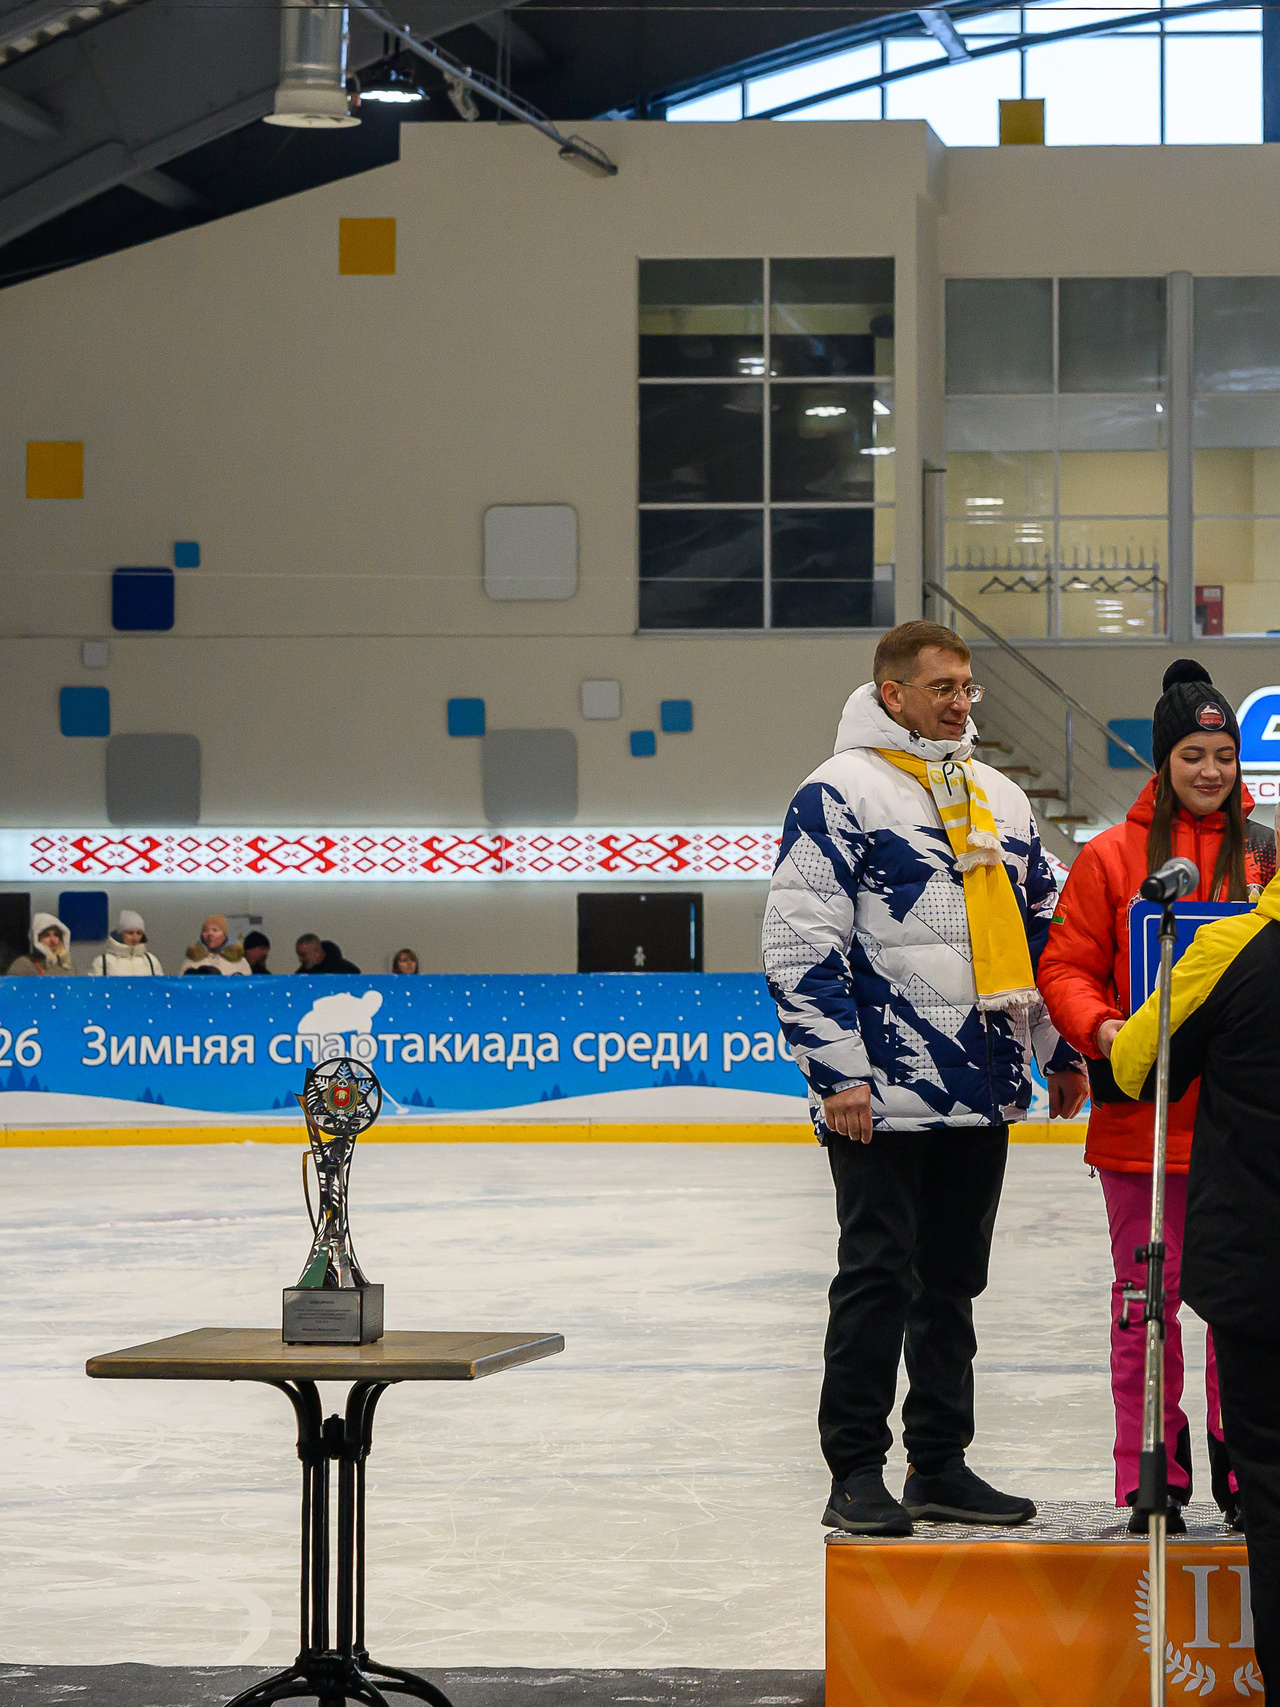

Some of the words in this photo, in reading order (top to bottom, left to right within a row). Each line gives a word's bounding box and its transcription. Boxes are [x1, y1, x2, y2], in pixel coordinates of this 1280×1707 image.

[82, 1025, 255, 1066] Зимняя
[268, 1031, 560, 1071] спартакиада
[572, 1031, 708, 1071] среди
